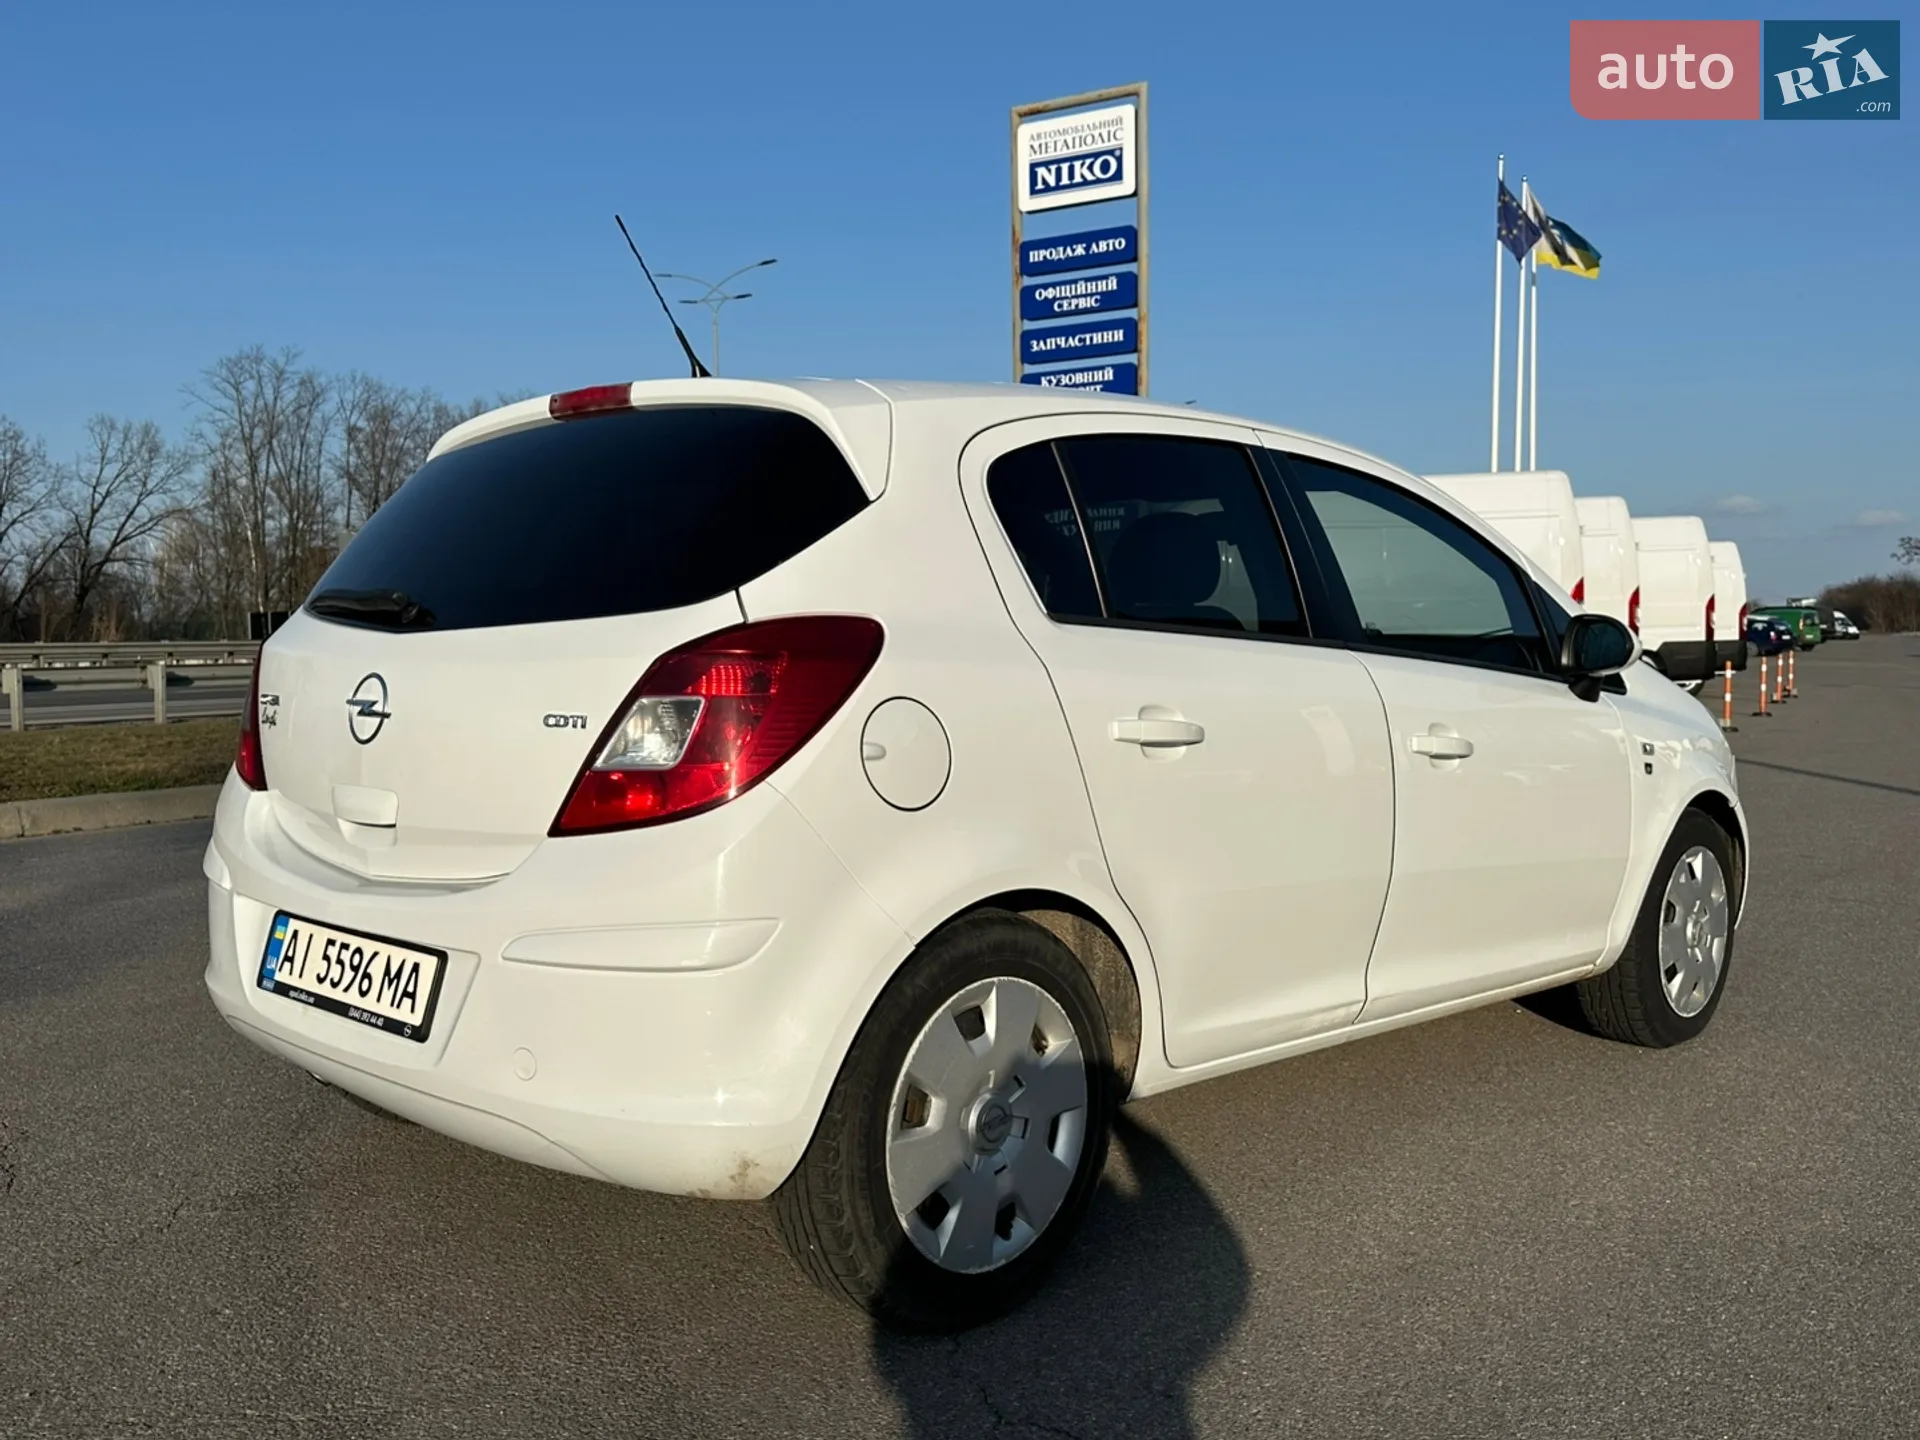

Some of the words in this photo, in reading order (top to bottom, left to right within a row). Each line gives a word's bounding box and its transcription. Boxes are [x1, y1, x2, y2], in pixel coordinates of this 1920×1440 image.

[1029, 127, 1124, 157] МЕГАПОЛІС
[1034, 155, 1118, 190] NIKO
[1029, 243, 1086, 263] ПРОДАЖ
[1089, 237, 1126, 254] АВТО
[1035, 276, 1118, 301] ОФІЦІЙНИЙ
[1053, 295, 1101, 312] СЕРВІС
[1030, 329, 1124, 352] ЗАПЧАСТИНИ
[1040, 367, 1114, 388] КУЗОВНИЙ
[278, 929, 313, 979] AI
[316, 938, 380, 998] 5596
[376, 954, 421, 1014] MA
